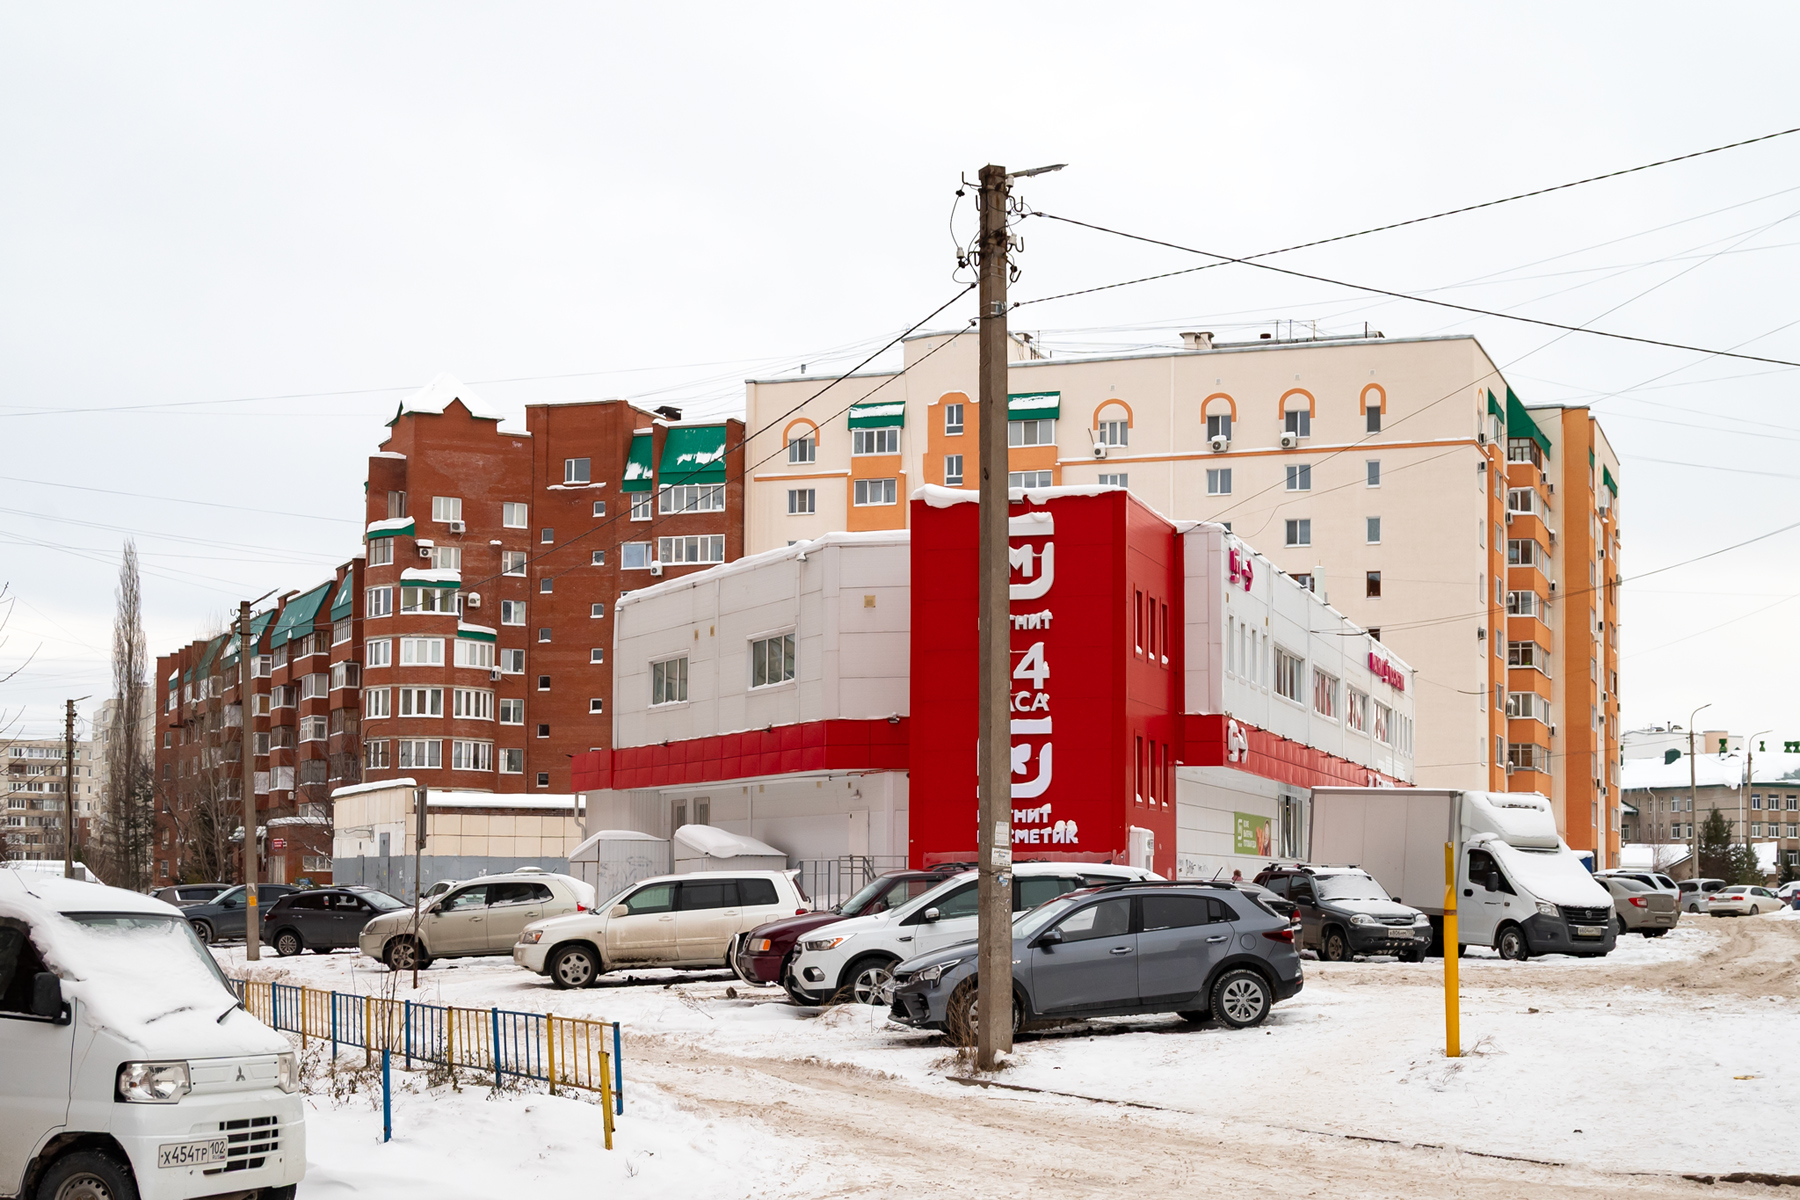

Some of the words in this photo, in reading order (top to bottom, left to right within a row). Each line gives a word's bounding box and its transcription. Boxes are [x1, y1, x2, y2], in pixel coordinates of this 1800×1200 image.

[978, 612, 1053, 630] НИТ
[1010, 642, 1050, 689] 4
[1010, 691, 1049, 712] СА
[977, 807, 1052, 823] НИТ
[977, 824, 1079, 844] МЕТИК
[163, 1145, 208, 1165] Х454ТР
[210, 1141, 225, 1155] 102
